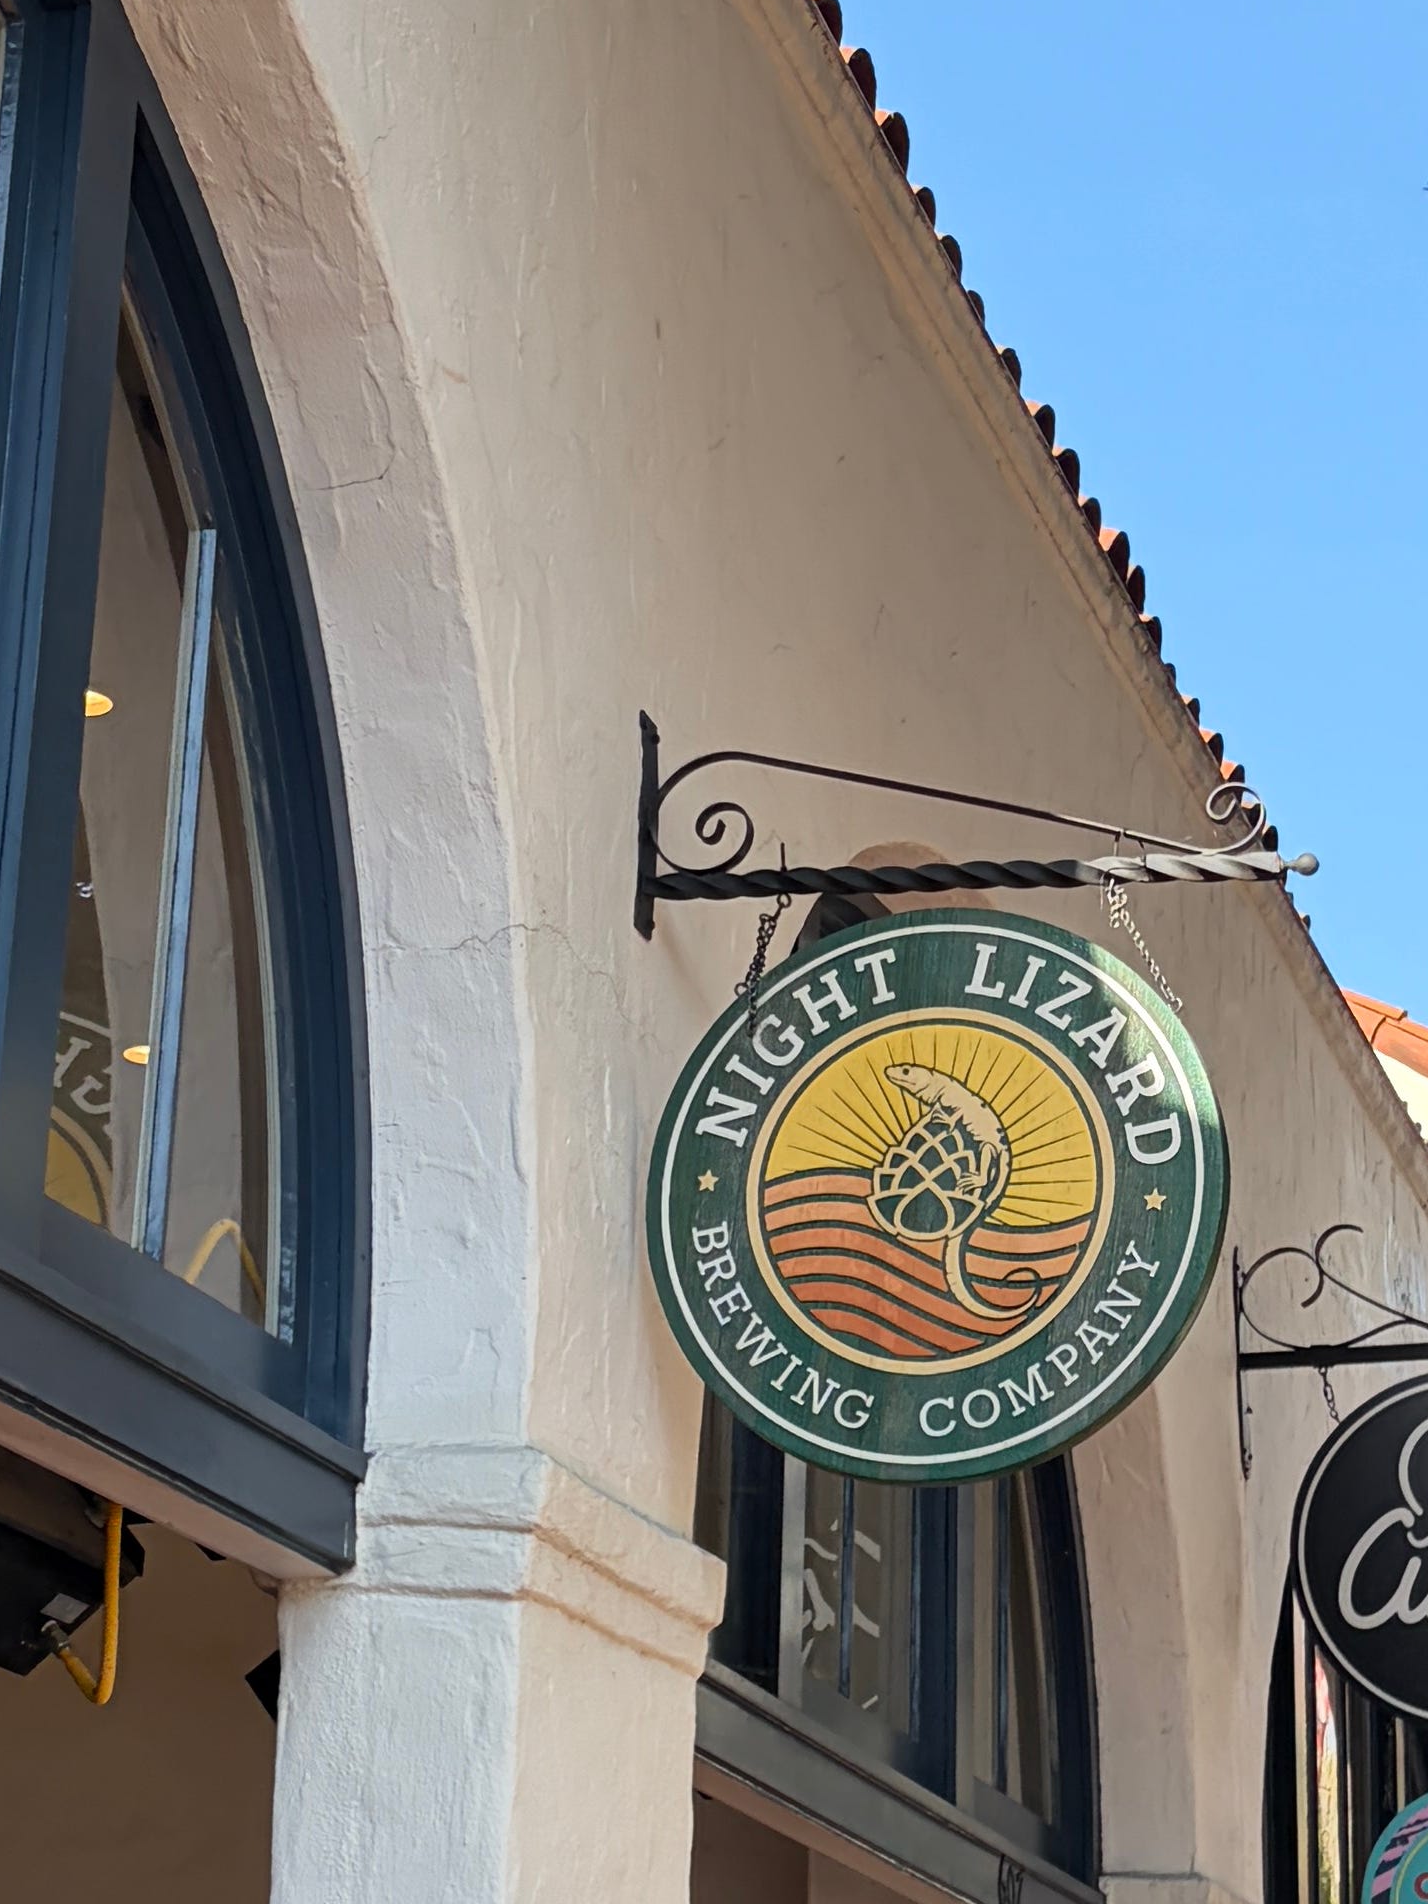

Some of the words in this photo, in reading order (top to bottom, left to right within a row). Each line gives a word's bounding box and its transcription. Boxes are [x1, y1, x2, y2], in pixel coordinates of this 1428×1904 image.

[695, 948, 897, 1149] NIGHT
[963, 943, 1183, 1166] LIZARD
[691, 1220, 876, 1431] BREWING
[918, 1240, 1160, 1438] COMPANY
